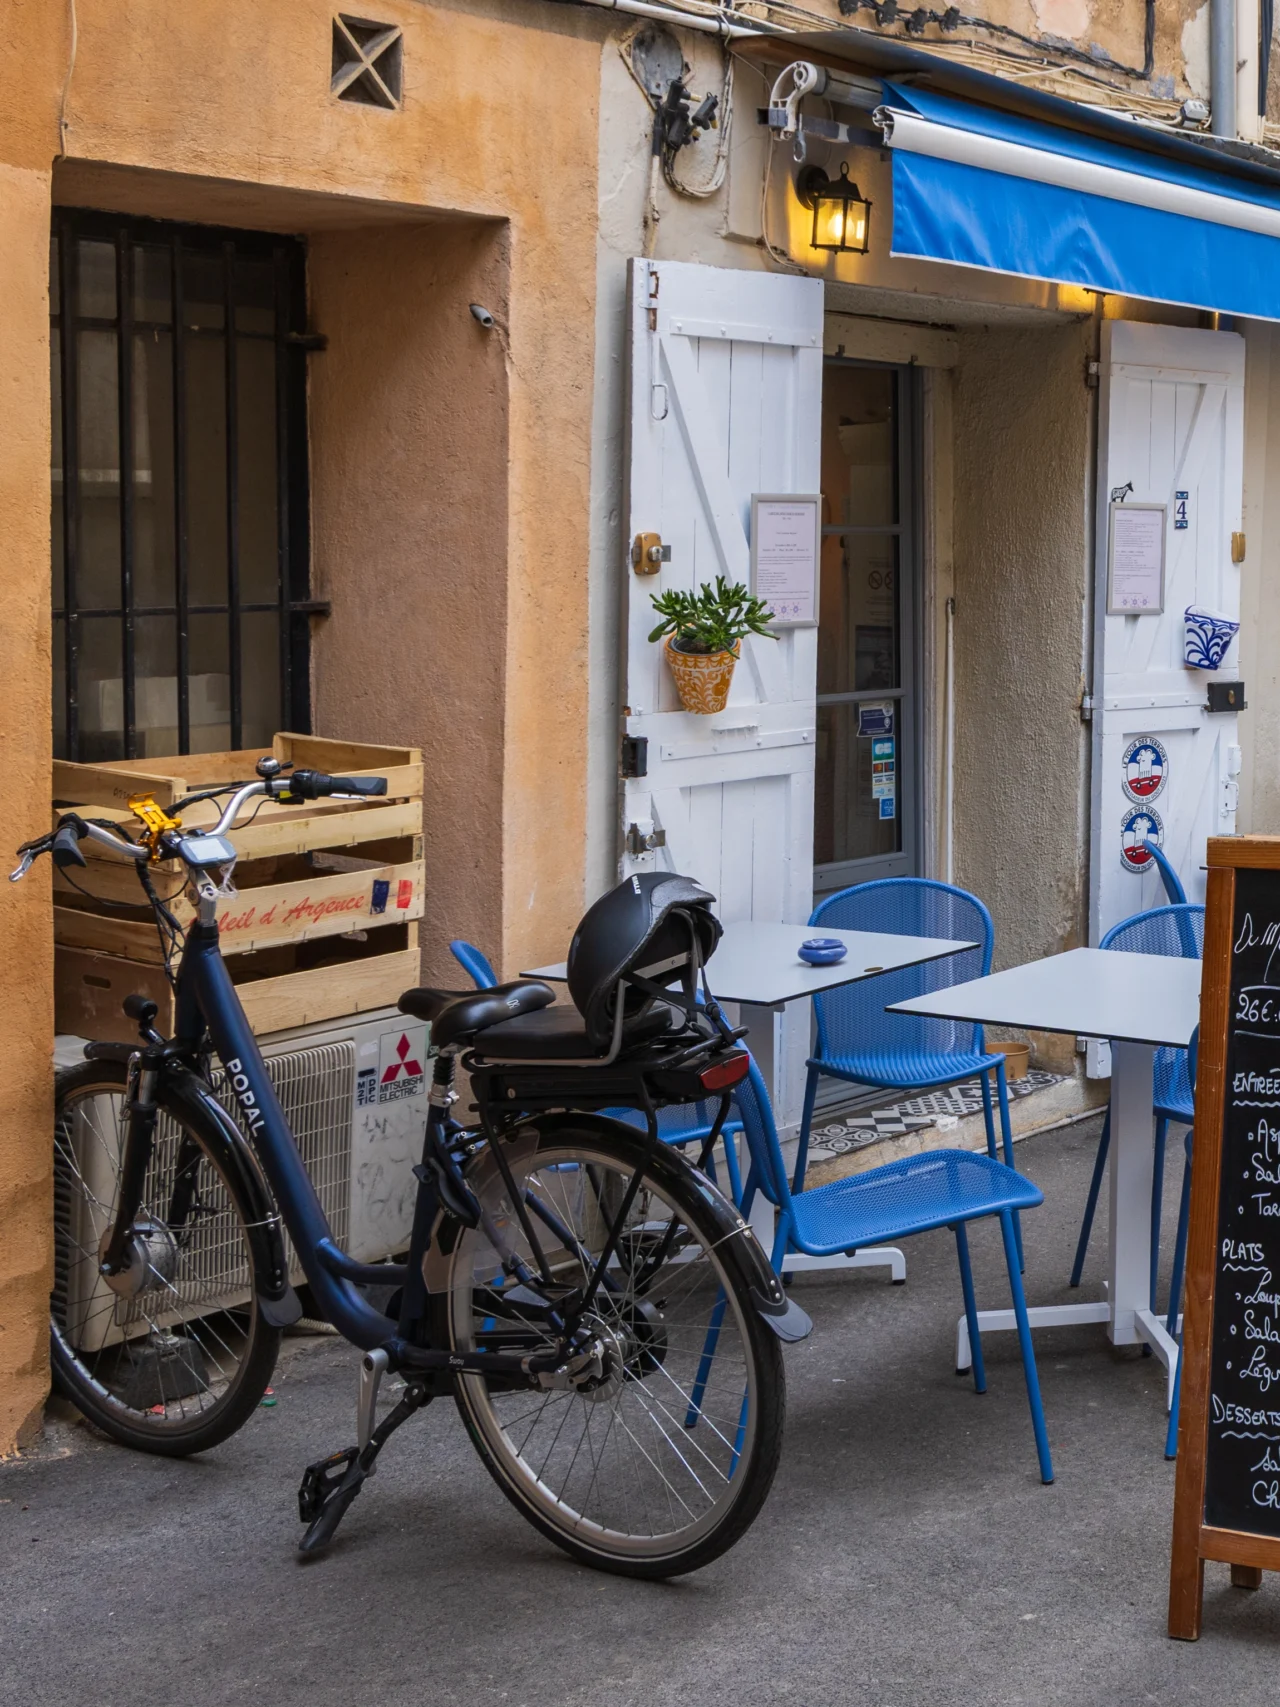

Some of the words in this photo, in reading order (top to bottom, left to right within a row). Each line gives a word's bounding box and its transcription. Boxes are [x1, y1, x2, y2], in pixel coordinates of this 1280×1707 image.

[1176, 501, 1187, 519] 4
[1125, 742, 1138, 759] TOUR
[1138, 738, 1148, 746] DES
[1149, 738, 1167, 764] TERROIRS
[1121, 812, 1134, 827] TOUR
[1134, 806, 1144, 814] DES
[1145, 806, 1163, 831] TERROIRS
[379, 1085, 418, 1102] ELECTRIC
[380, 1075, 424, 1093] MITSUBISHI
[226, 1058, 265, 1137] POPAL
[1222, 1238, 1265, 1262] PLATS
